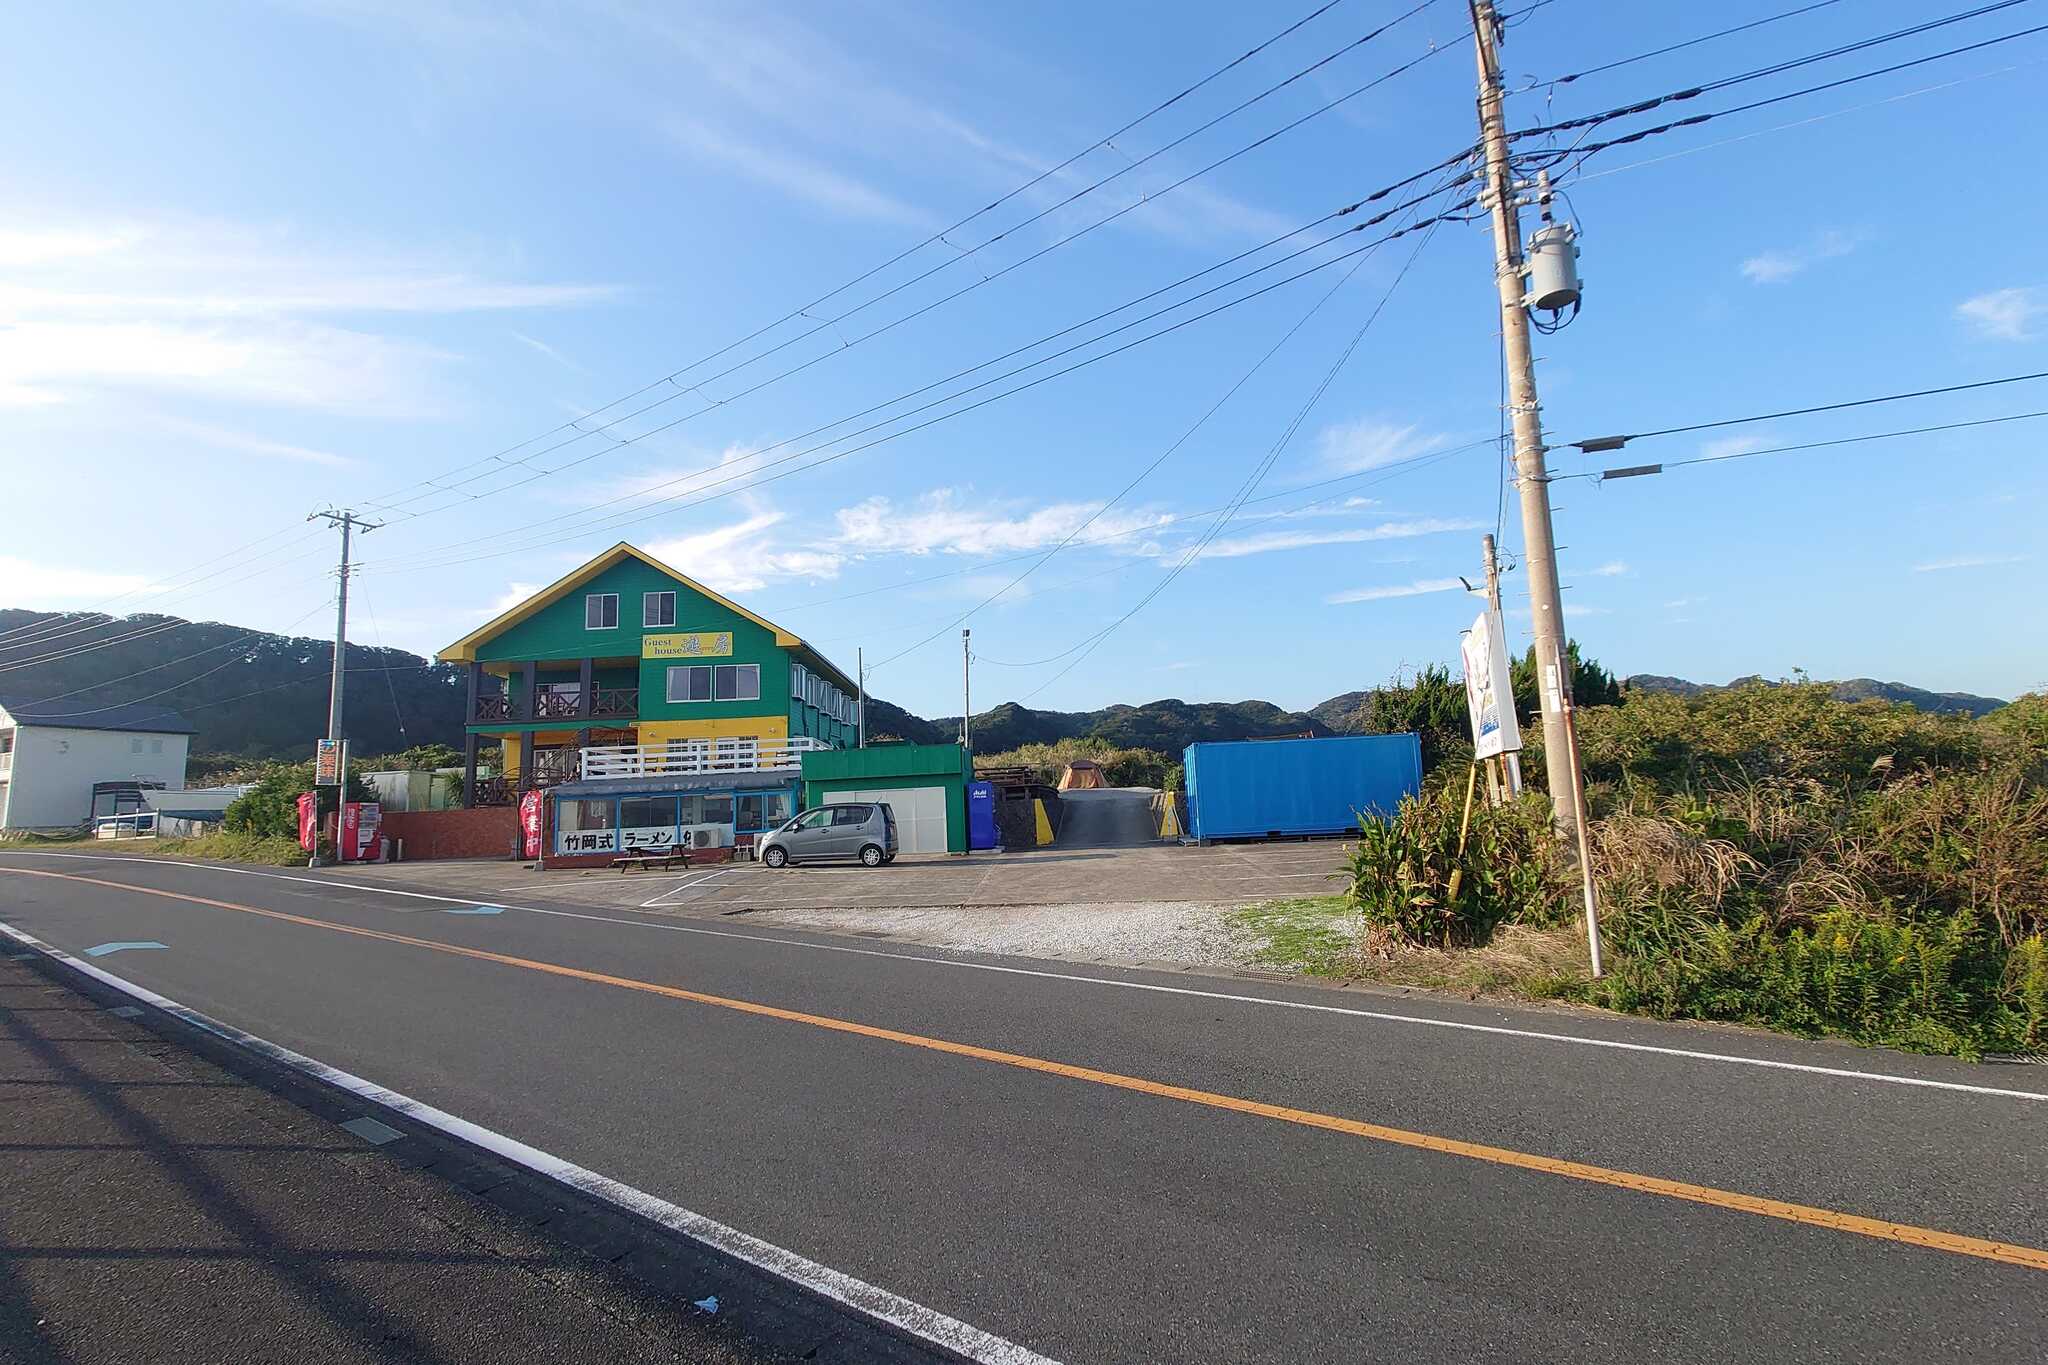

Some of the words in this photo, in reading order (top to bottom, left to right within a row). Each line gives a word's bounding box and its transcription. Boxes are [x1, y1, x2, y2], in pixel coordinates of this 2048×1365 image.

[654, 647, 682, 655] house
[526, 795, 539, 853] 営業中
[564, 834, 614, 851] 竹岡式
[624, 831, 673, 846] ラーメン
